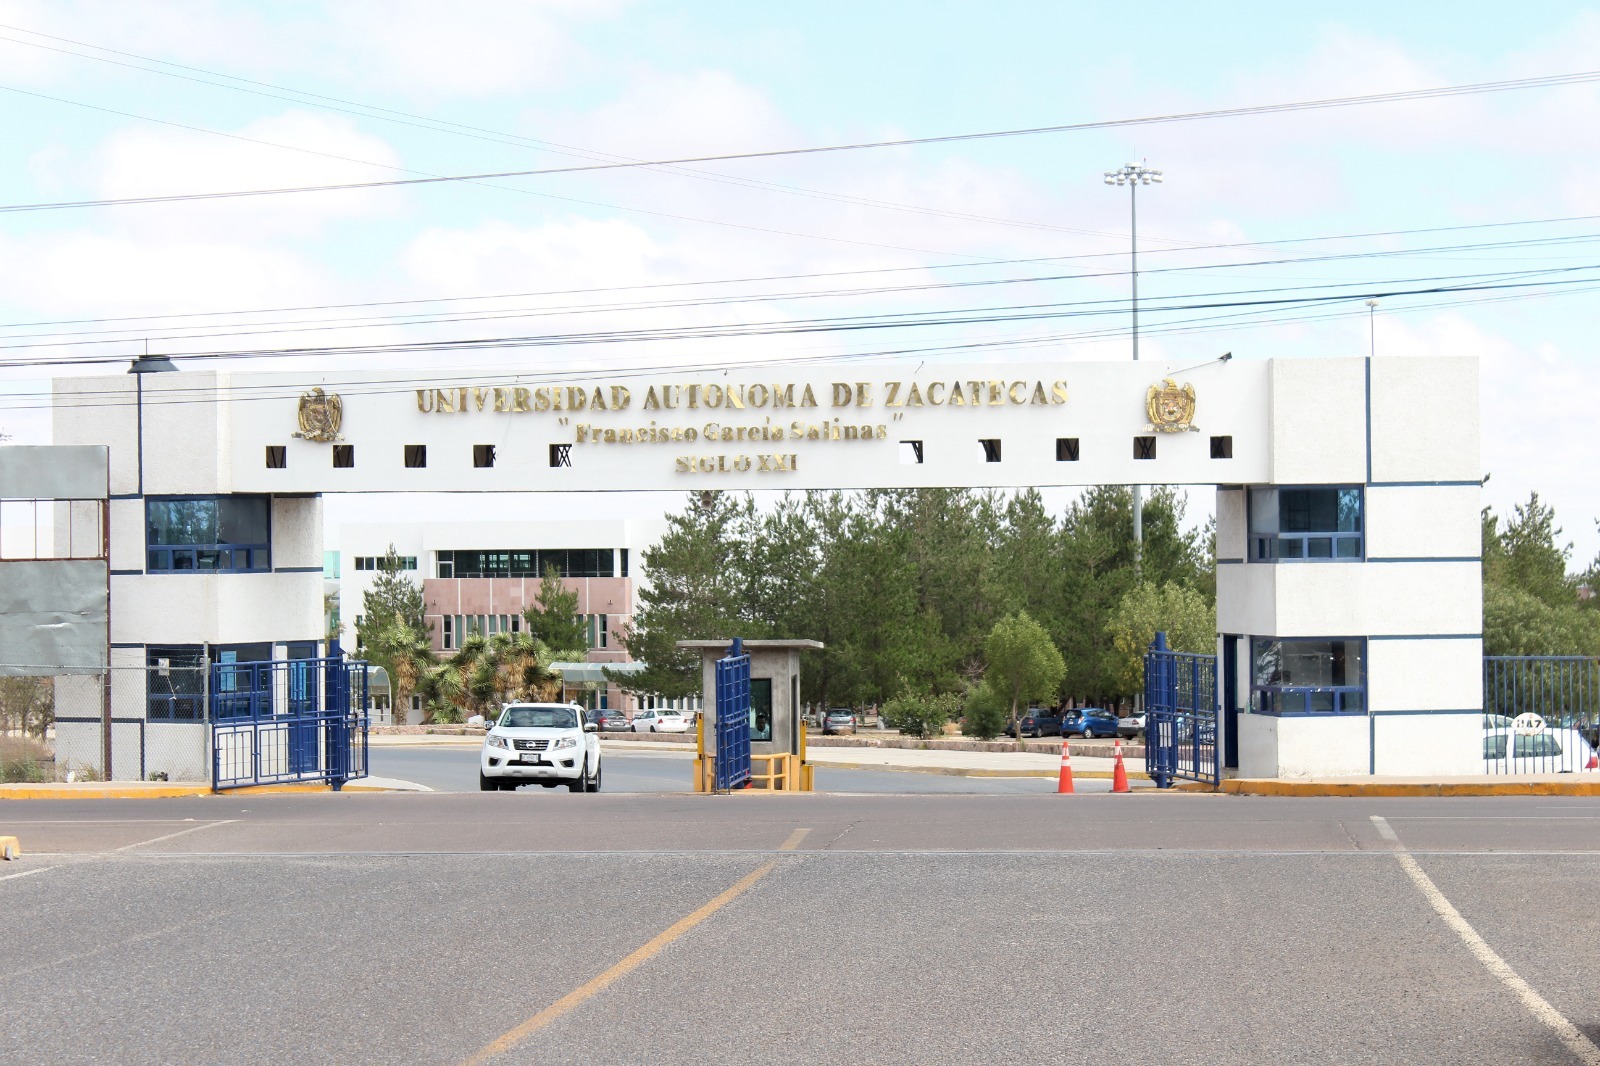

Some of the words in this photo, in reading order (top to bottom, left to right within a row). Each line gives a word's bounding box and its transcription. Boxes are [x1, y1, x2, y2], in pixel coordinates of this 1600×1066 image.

[415, 385, 631, 413] UNIVERSIDAD
[642, 383, 818, 410] AUTONOMA
[831, 382, 874, 408] DE
[884, 380, 1068, 406] ZACATECAS
[675, 455, 752, 473] SIGLO
[756, 454, 798, 472] XXI
